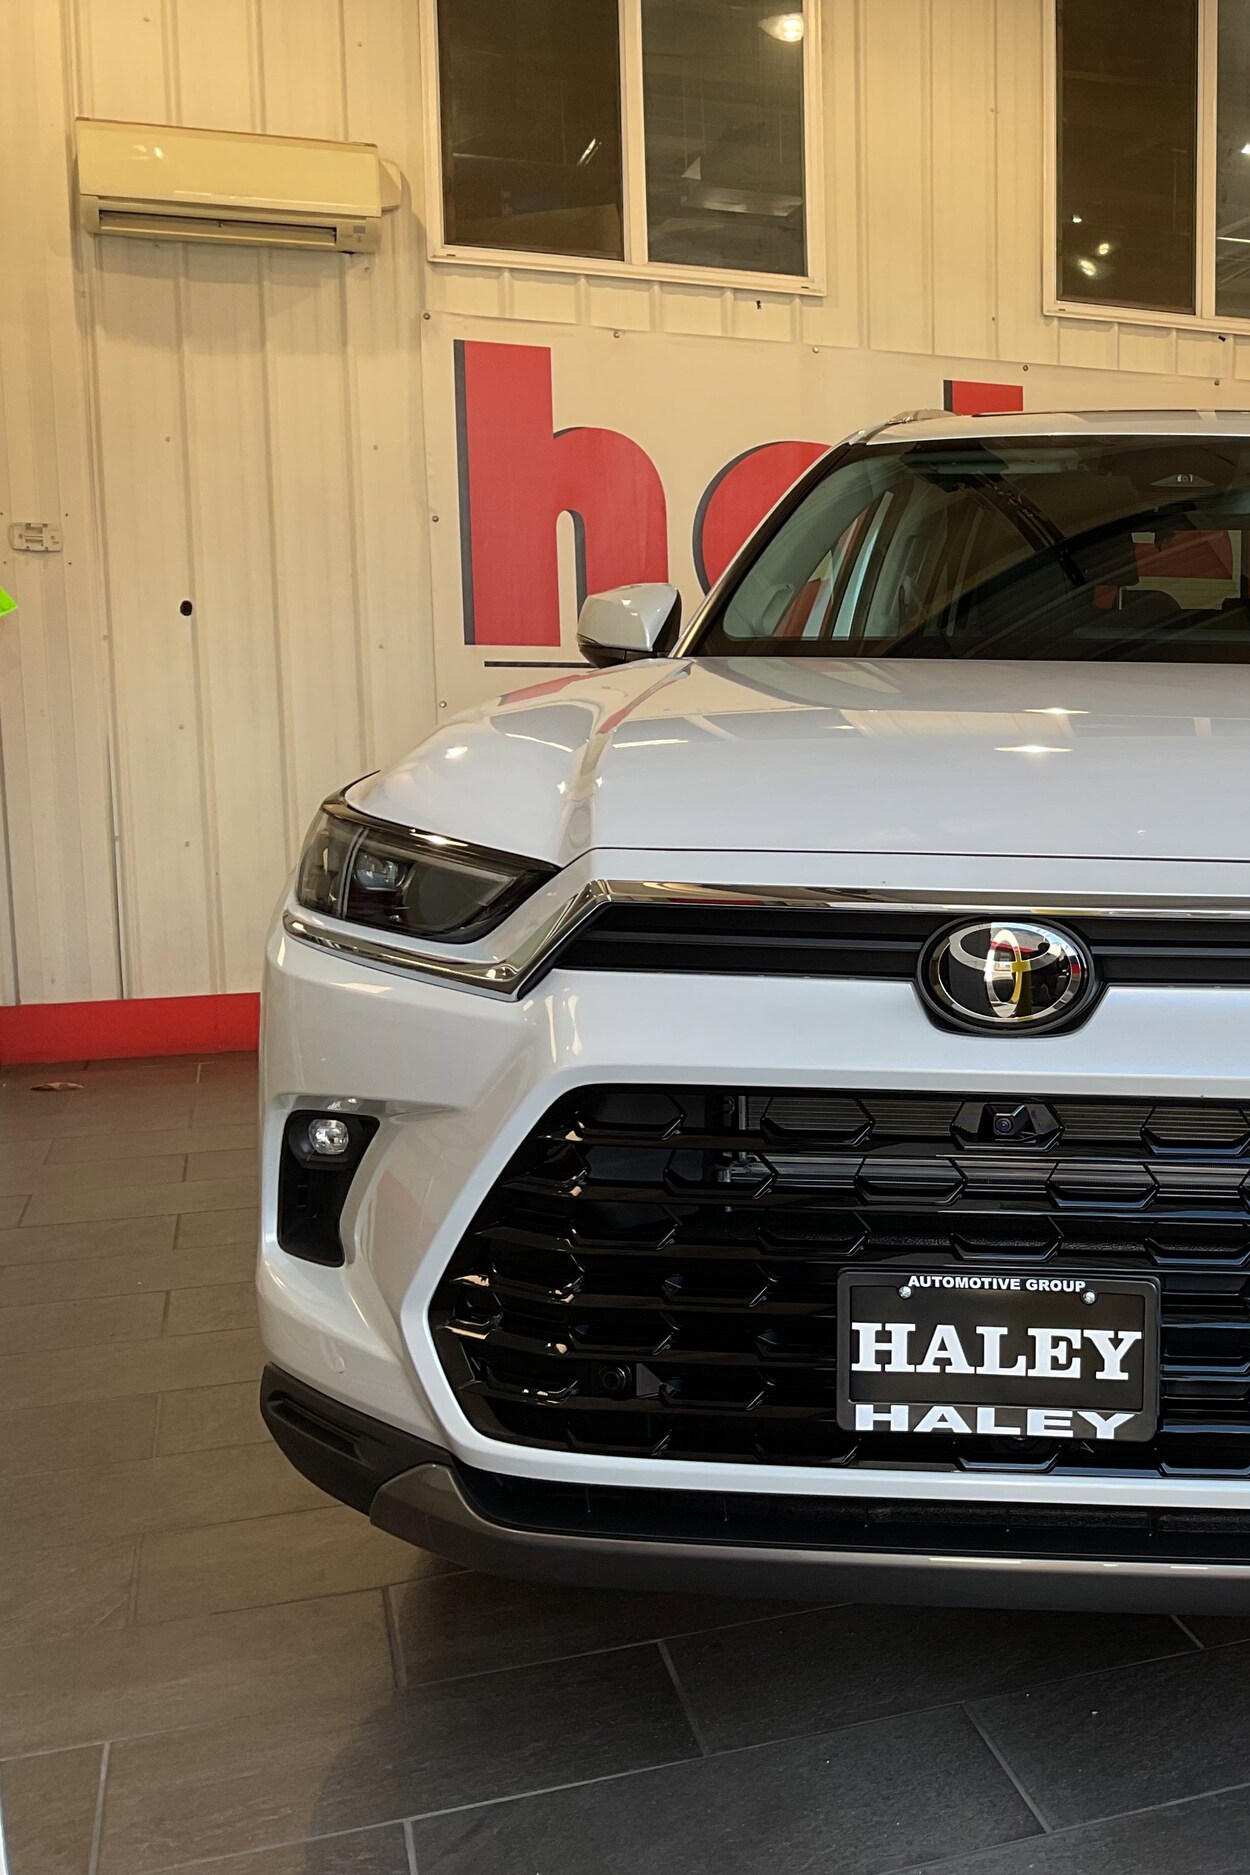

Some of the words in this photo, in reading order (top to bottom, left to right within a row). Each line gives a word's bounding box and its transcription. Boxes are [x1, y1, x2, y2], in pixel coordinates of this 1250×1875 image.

[908, 1275, 1020, 1290] AUTOMOTIVE
[1025, 1279, 1086, 1293] GROUP
[851, 1322, 1142, 1380] HALEY
[855, 1404, 1134, 1439] HALEY
